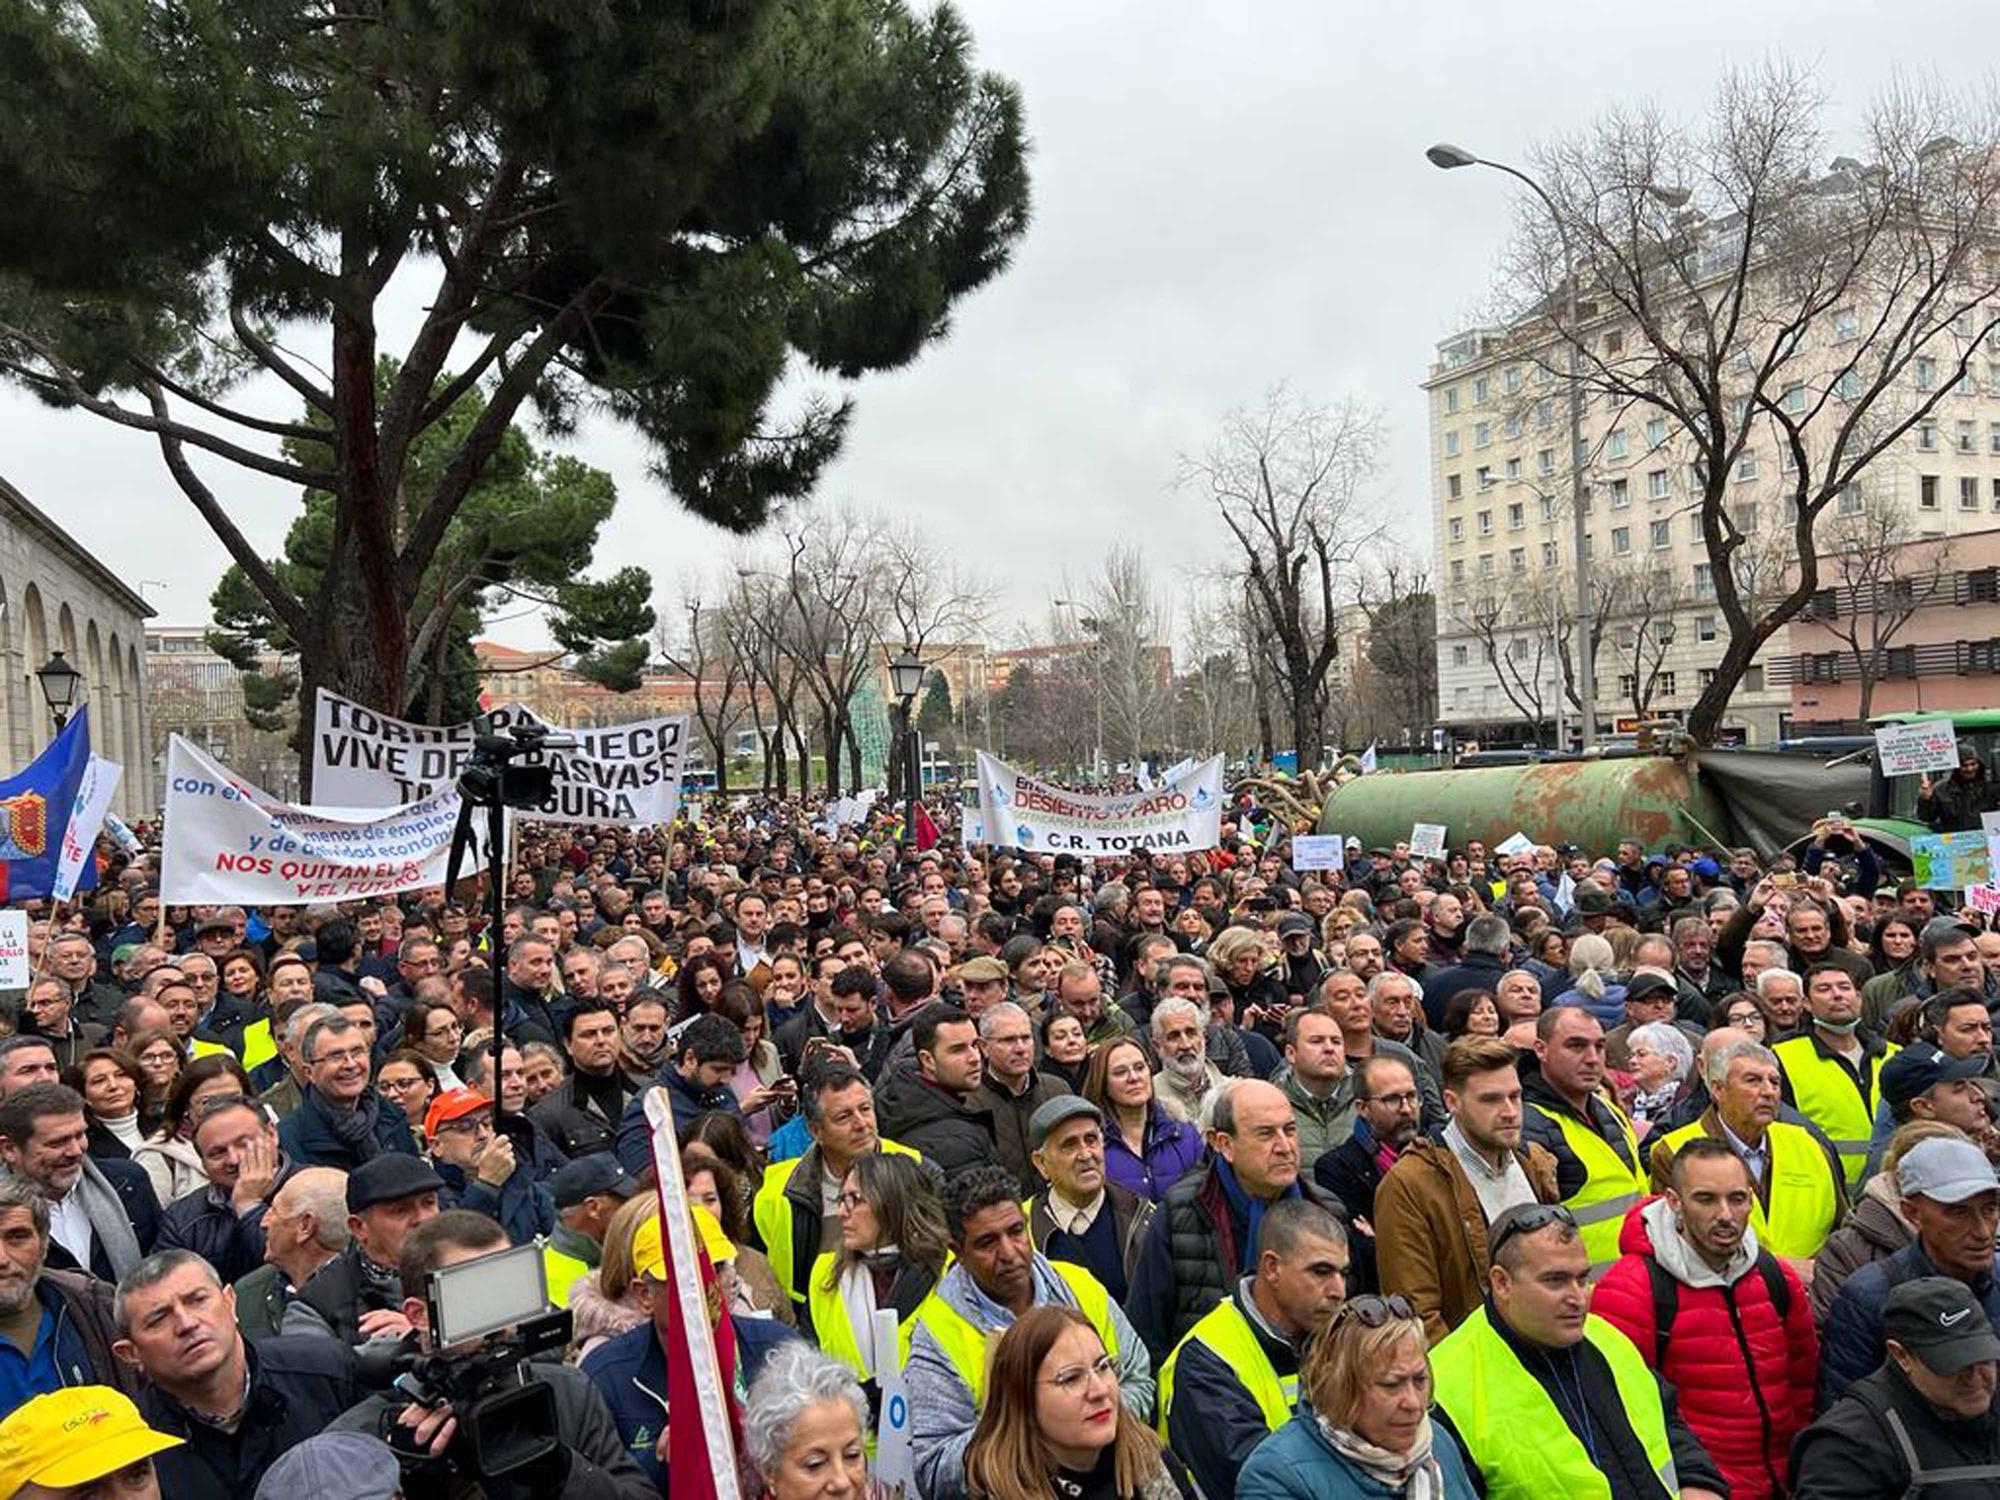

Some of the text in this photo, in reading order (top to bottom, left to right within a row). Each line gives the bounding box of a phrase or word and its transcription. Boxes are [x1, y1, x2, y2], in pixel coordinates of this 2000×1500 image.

[322, 696, 471, 743] TORRE
[322, 734, 408, 776] VIVE
[173, 778, 215, 796] con
[363, 823, 386, 841] de
[388, 811, 456, 840] empleo
[249, 835, 263, 852] y
[268, 834, 297, 854] de
[1047, 829, 1191, 850] C.R. TOTANA
[216, 853, 398, 880] NOS QUITAN EL
[315, 883, 338, 897] EL
